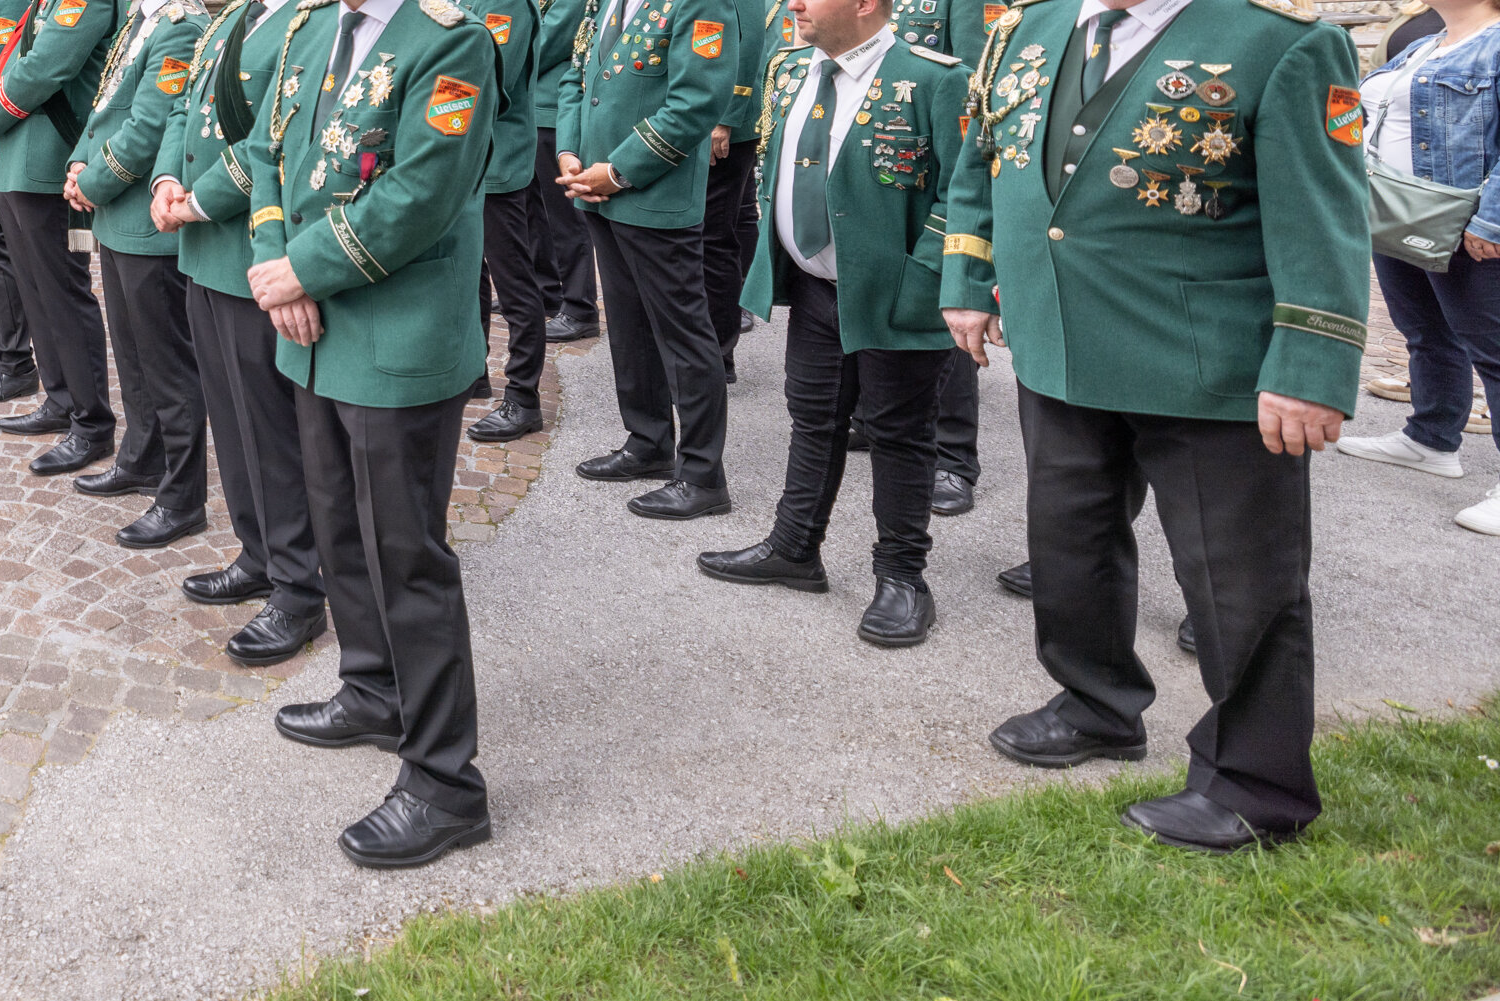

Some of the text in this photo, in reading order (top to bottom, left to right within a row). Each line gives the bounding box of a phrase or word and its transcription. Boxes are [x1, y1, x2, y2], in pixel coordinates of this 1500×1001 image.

[491, 24, 509, 35] elsen
[695, 33, 721, 48] Uelsen
[860, 38, 881, 54] Uelsen
[160, 71, 186, 82] Uelsen
[434, 100, 472, 115] Uelsen
[1333, 107, 1362, 128] Uelsen
[228, 162, 252, 194] VORSTA
